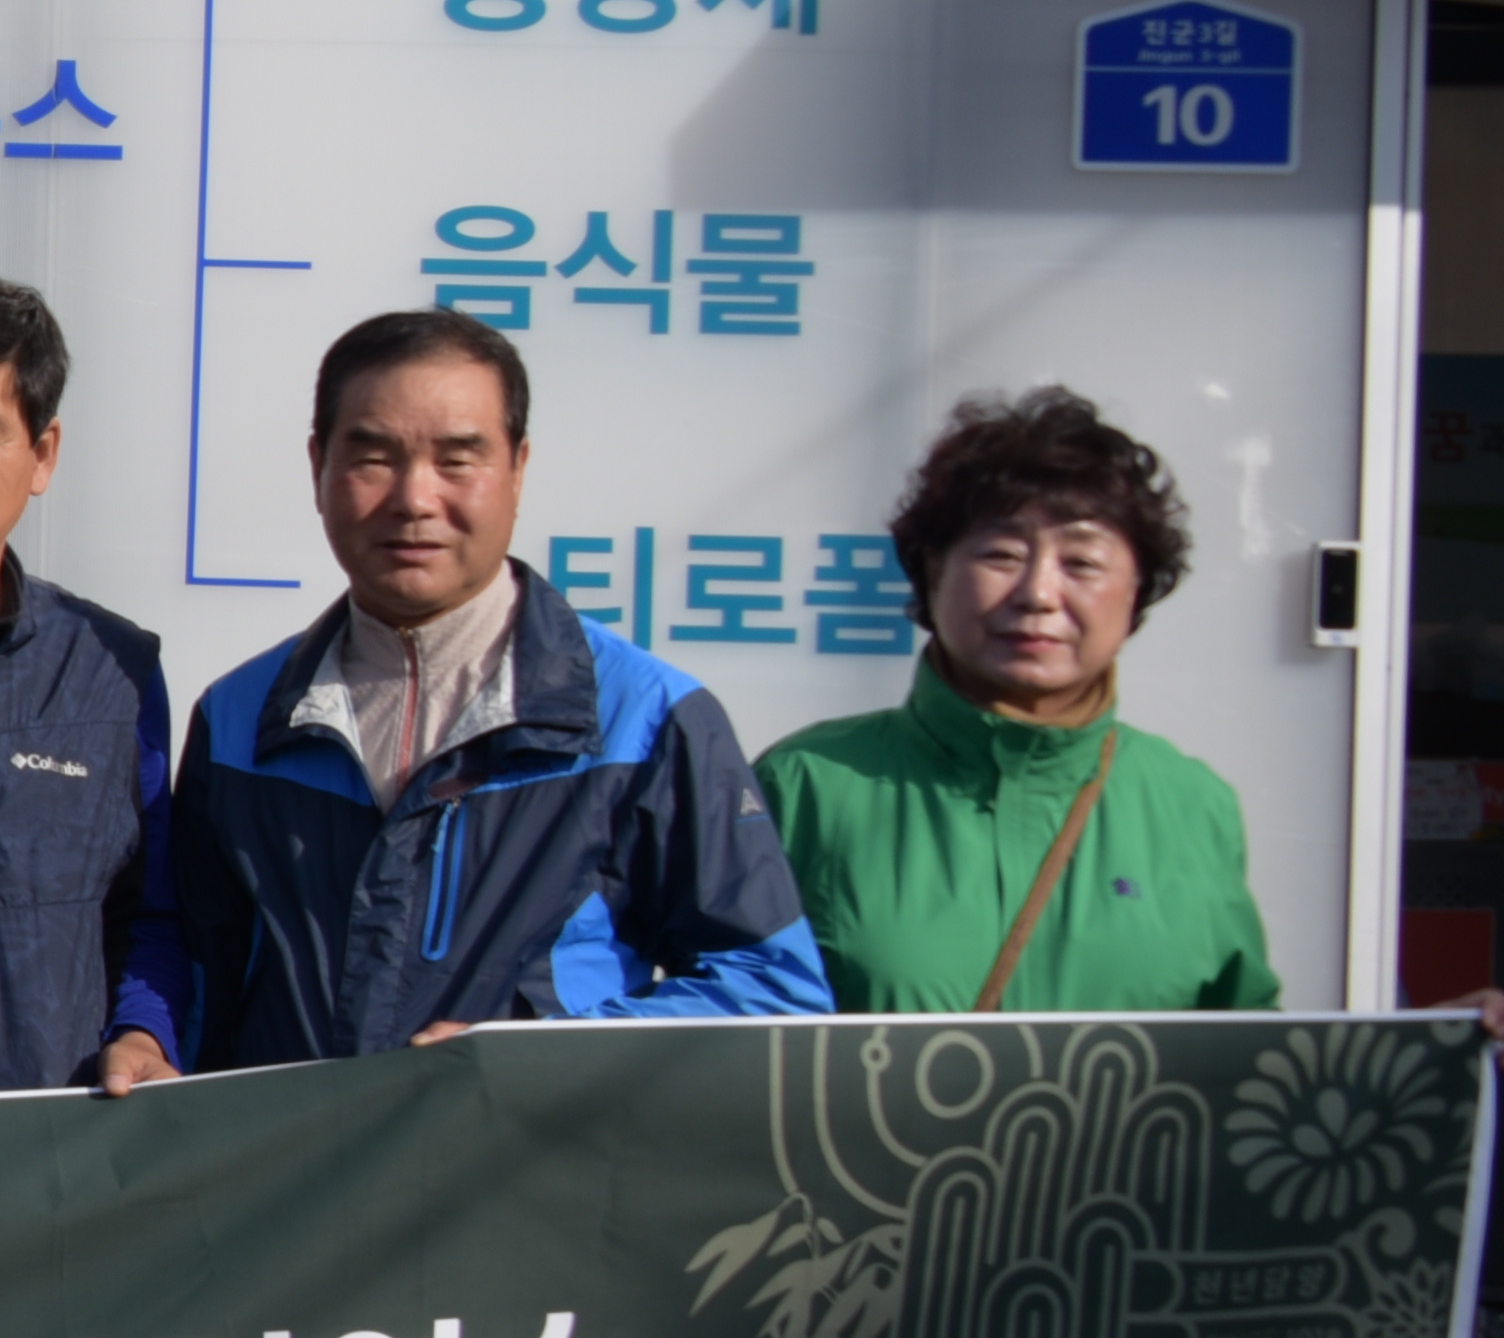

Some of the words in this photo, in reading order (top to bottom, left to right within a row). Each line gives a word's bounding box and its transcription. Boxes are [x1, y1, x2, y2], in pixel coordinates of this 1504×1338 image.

[1143, 85, 1234, 146] 10
[420, 204, 817, 337] 음식물
[548, 525, 915, 655] 티로폼
[27, 753, 89, 778] Columbia
